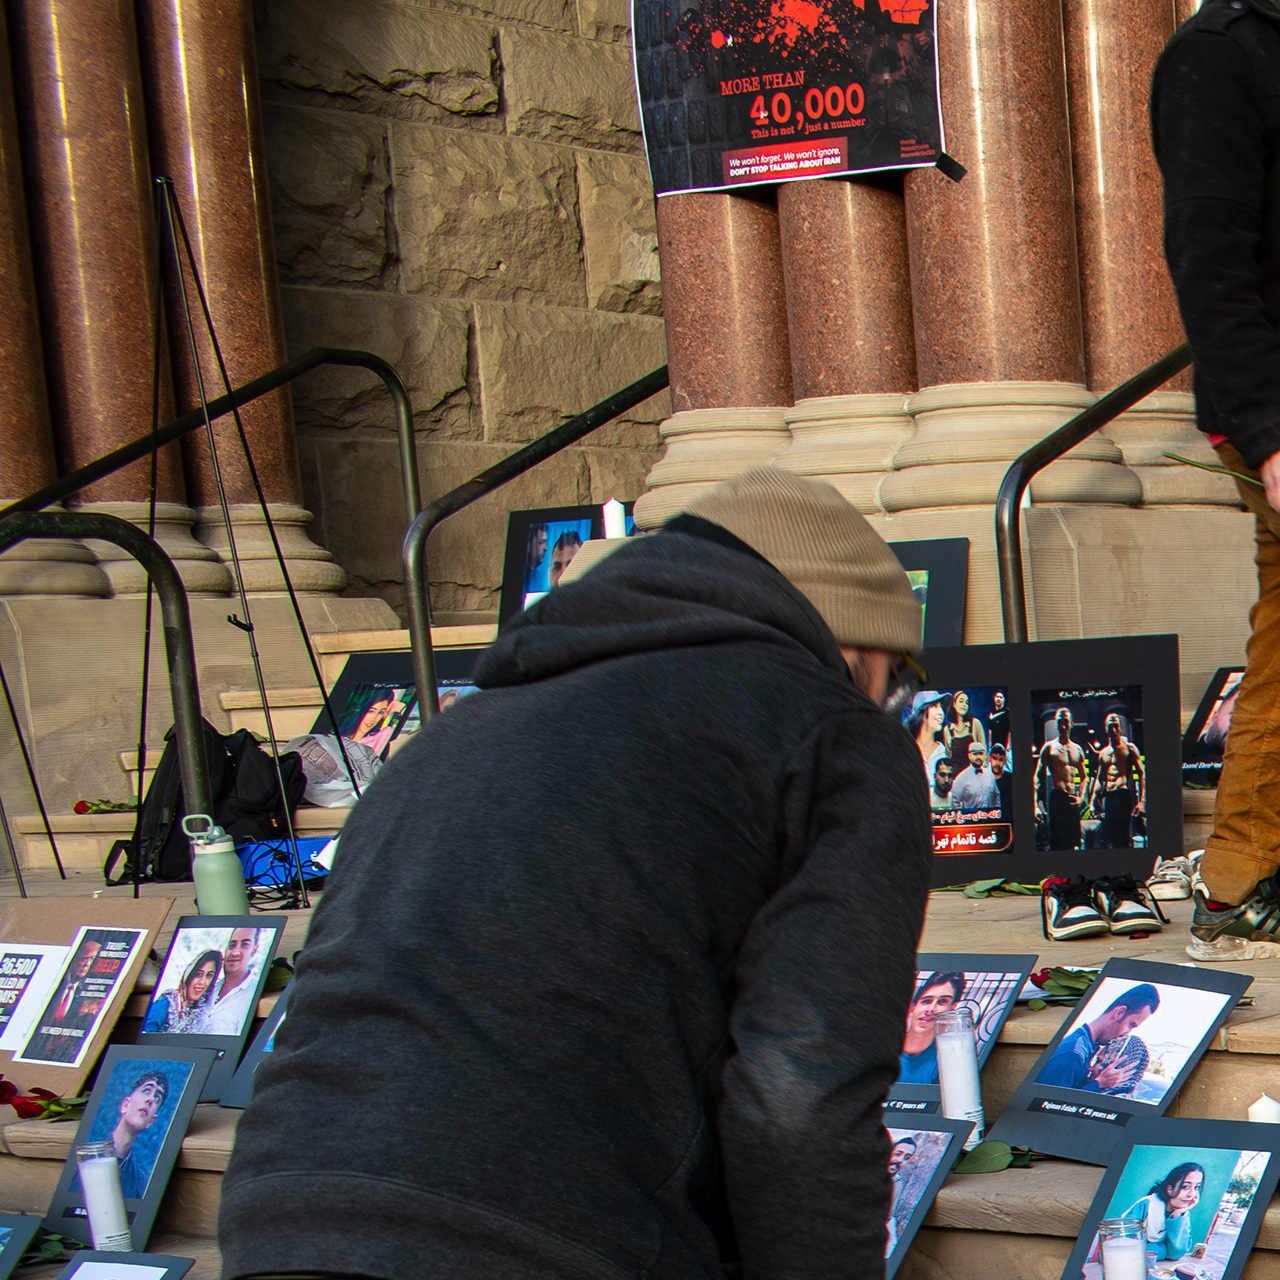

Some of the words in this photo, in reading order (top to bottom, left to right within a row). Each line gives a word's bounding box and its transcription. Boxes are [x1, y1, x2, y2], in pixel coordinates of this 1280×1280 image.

[720, 77, 760, 95] MORE
[763, 70, 805, 89] THAN
[750, 83, 864, 130] 40,000
[751, 129, 768, 138] This
[771, 128, 778, 136] is
[780, 125, 794, 135] not
[804, 122, 821, 134] just
[824, 122, 829, 130] a
[830, 118, 865, 130] number
[730, 158, 740, 167] We
[742, 156, 760, 166] won't
[762, 154, 782, 166] forget.
[784, 152, 794, 162] We
[796, 150, 816, 160] won't
[817, 147, 840, 158] ignore.
[730, 167, 750, 176] DON'T
[751, 165, 768, 174] STOP
[770, 162, 798, 173] TALKING
[799, 158, 824, 170] ABOUT
[824, 156, 841, 166] IRAN
[950, 832, 976, 850] ناتمام
[978, 831, 998, 844] قصه
[0, 958, 38, 976] 36,500
